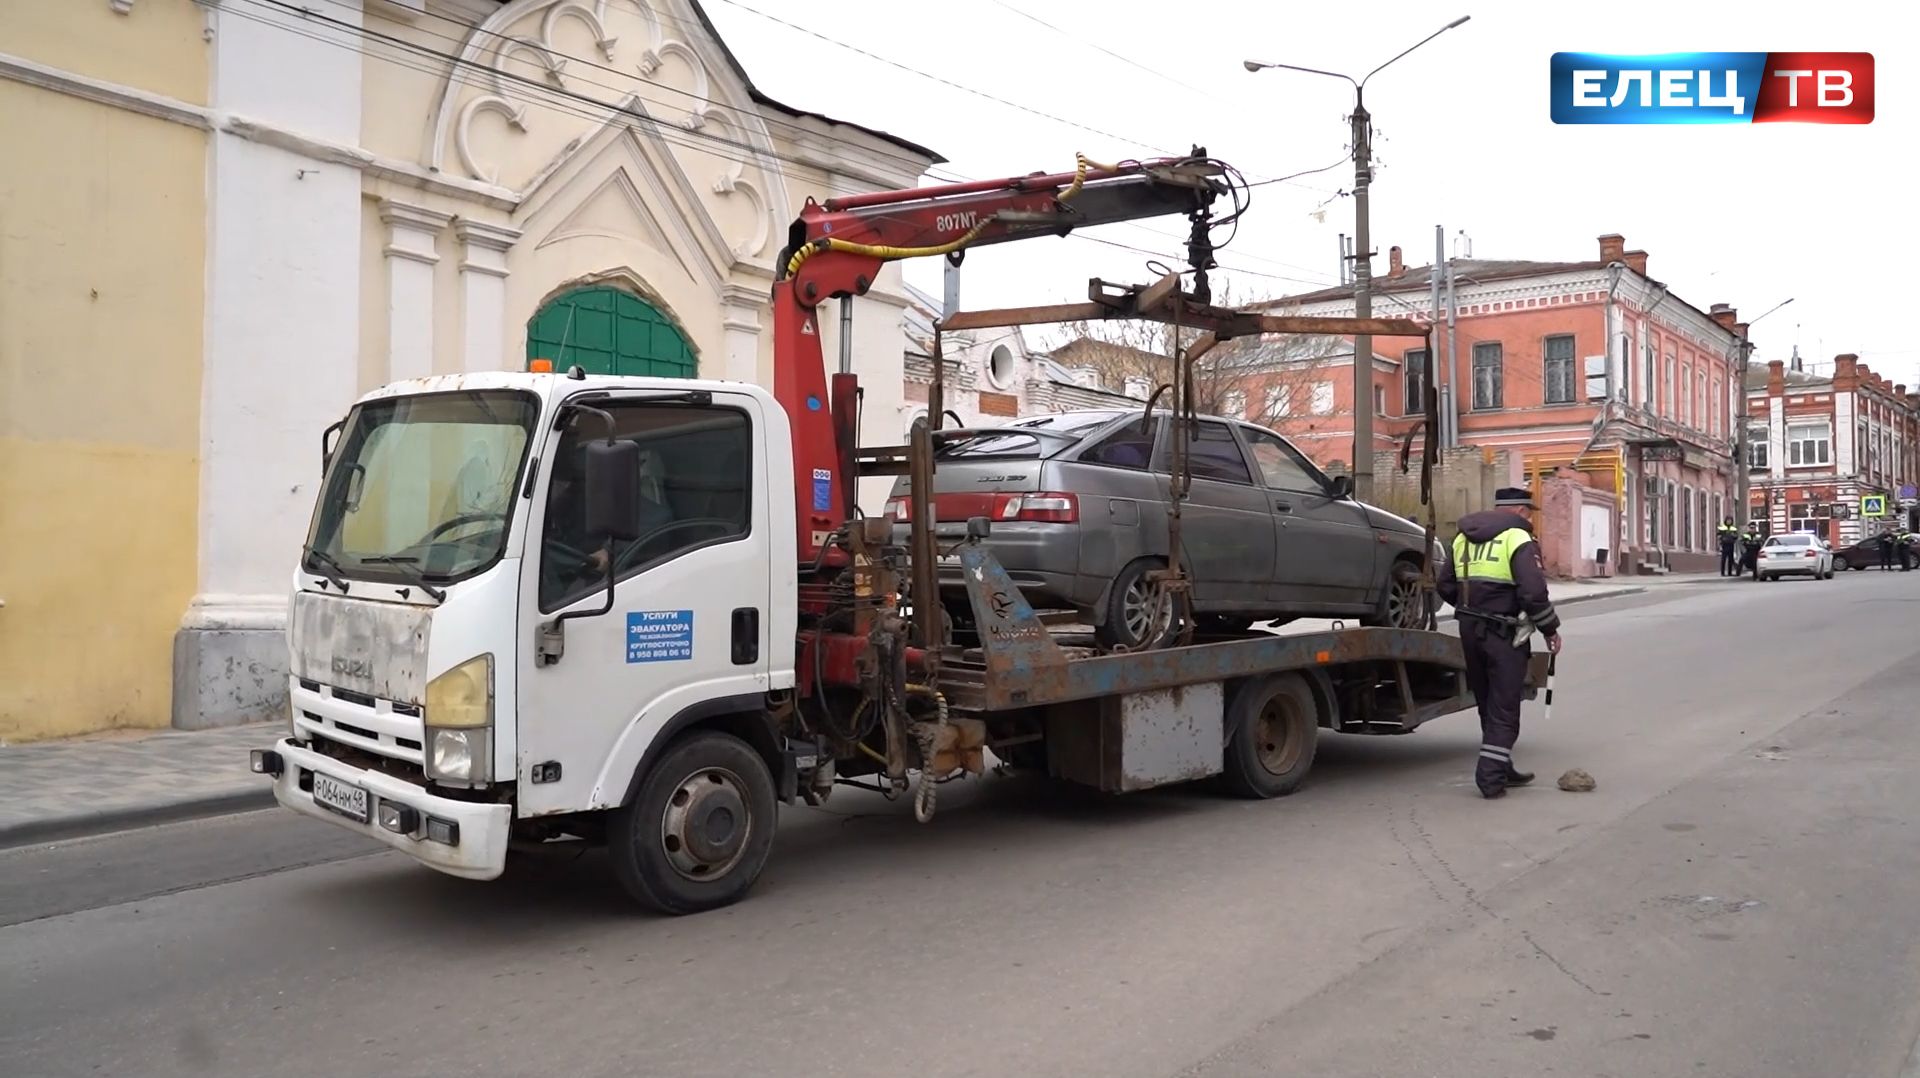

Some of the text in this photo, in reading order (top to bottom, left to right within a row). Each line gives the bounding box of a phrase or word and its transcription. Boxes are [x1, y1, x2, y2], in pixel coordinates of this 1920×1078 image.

[936, 210, 977, 233] 807NT
[642, 612, 678, 620] УСЛУГИ
[630, 623, 690, 633] ЭВАКУАТОРА
[630, 640, 690, 649] КРУГЛОСУТОЧНО
[332, 655, 373, 679] ISUZU
